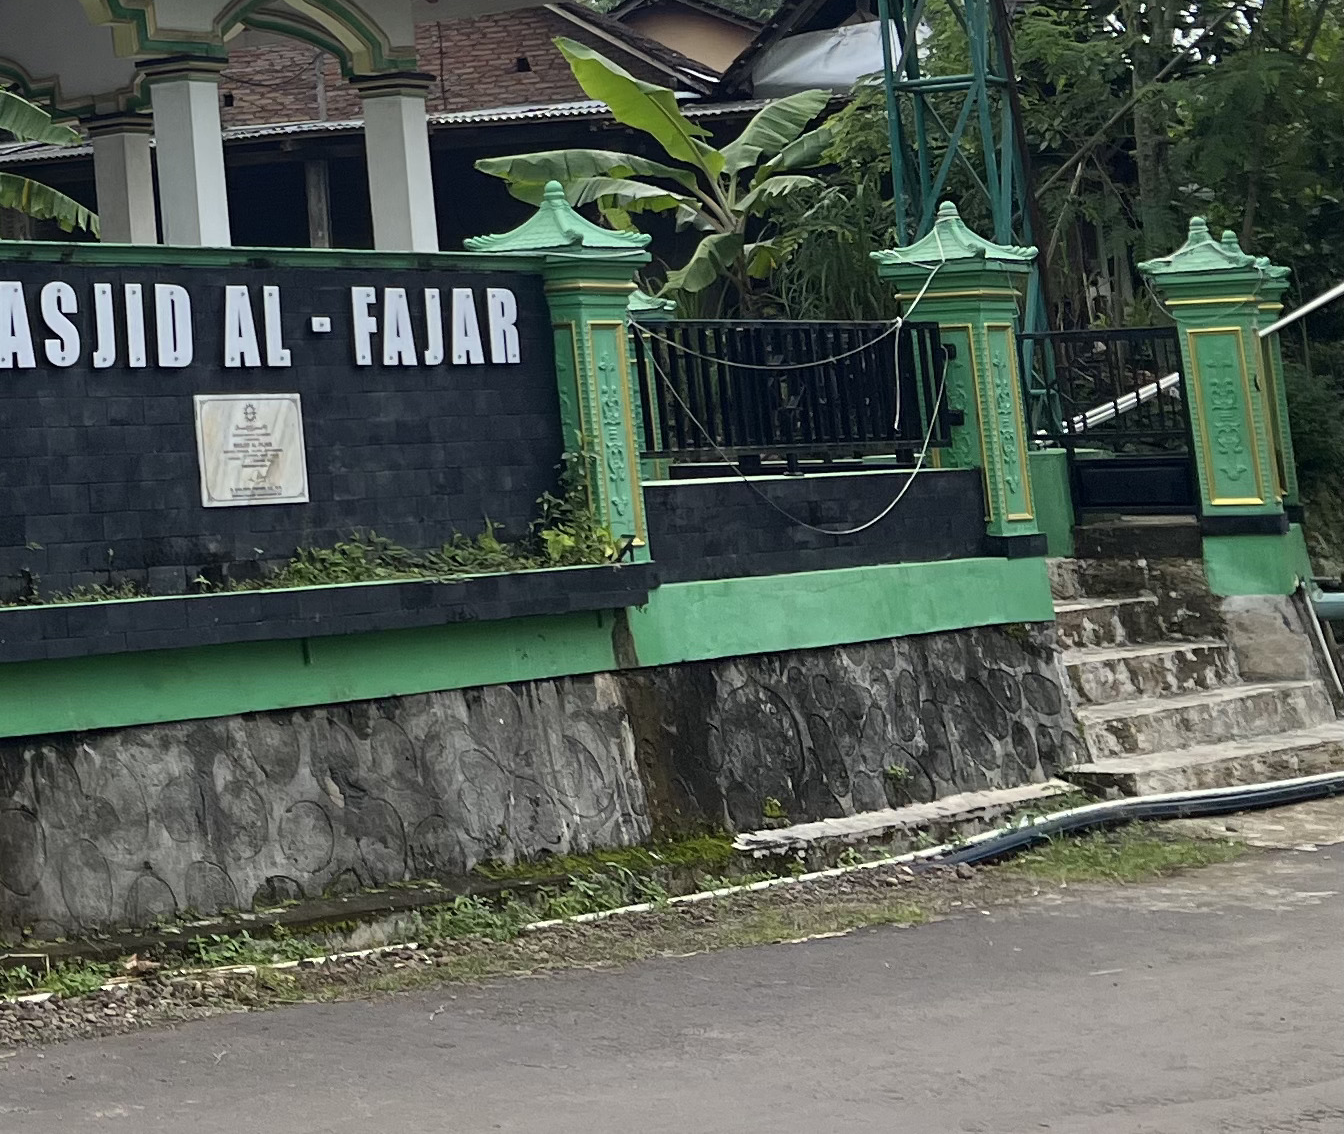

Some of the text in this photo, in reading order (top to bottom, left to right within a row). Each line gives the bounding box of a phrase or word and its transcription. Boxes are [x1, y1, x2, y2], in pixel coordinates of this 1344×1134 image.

[224, 284, 292, 368] AL
[311, 316, 331, 333] -
[351, 286, 521, 367] FAJAR
